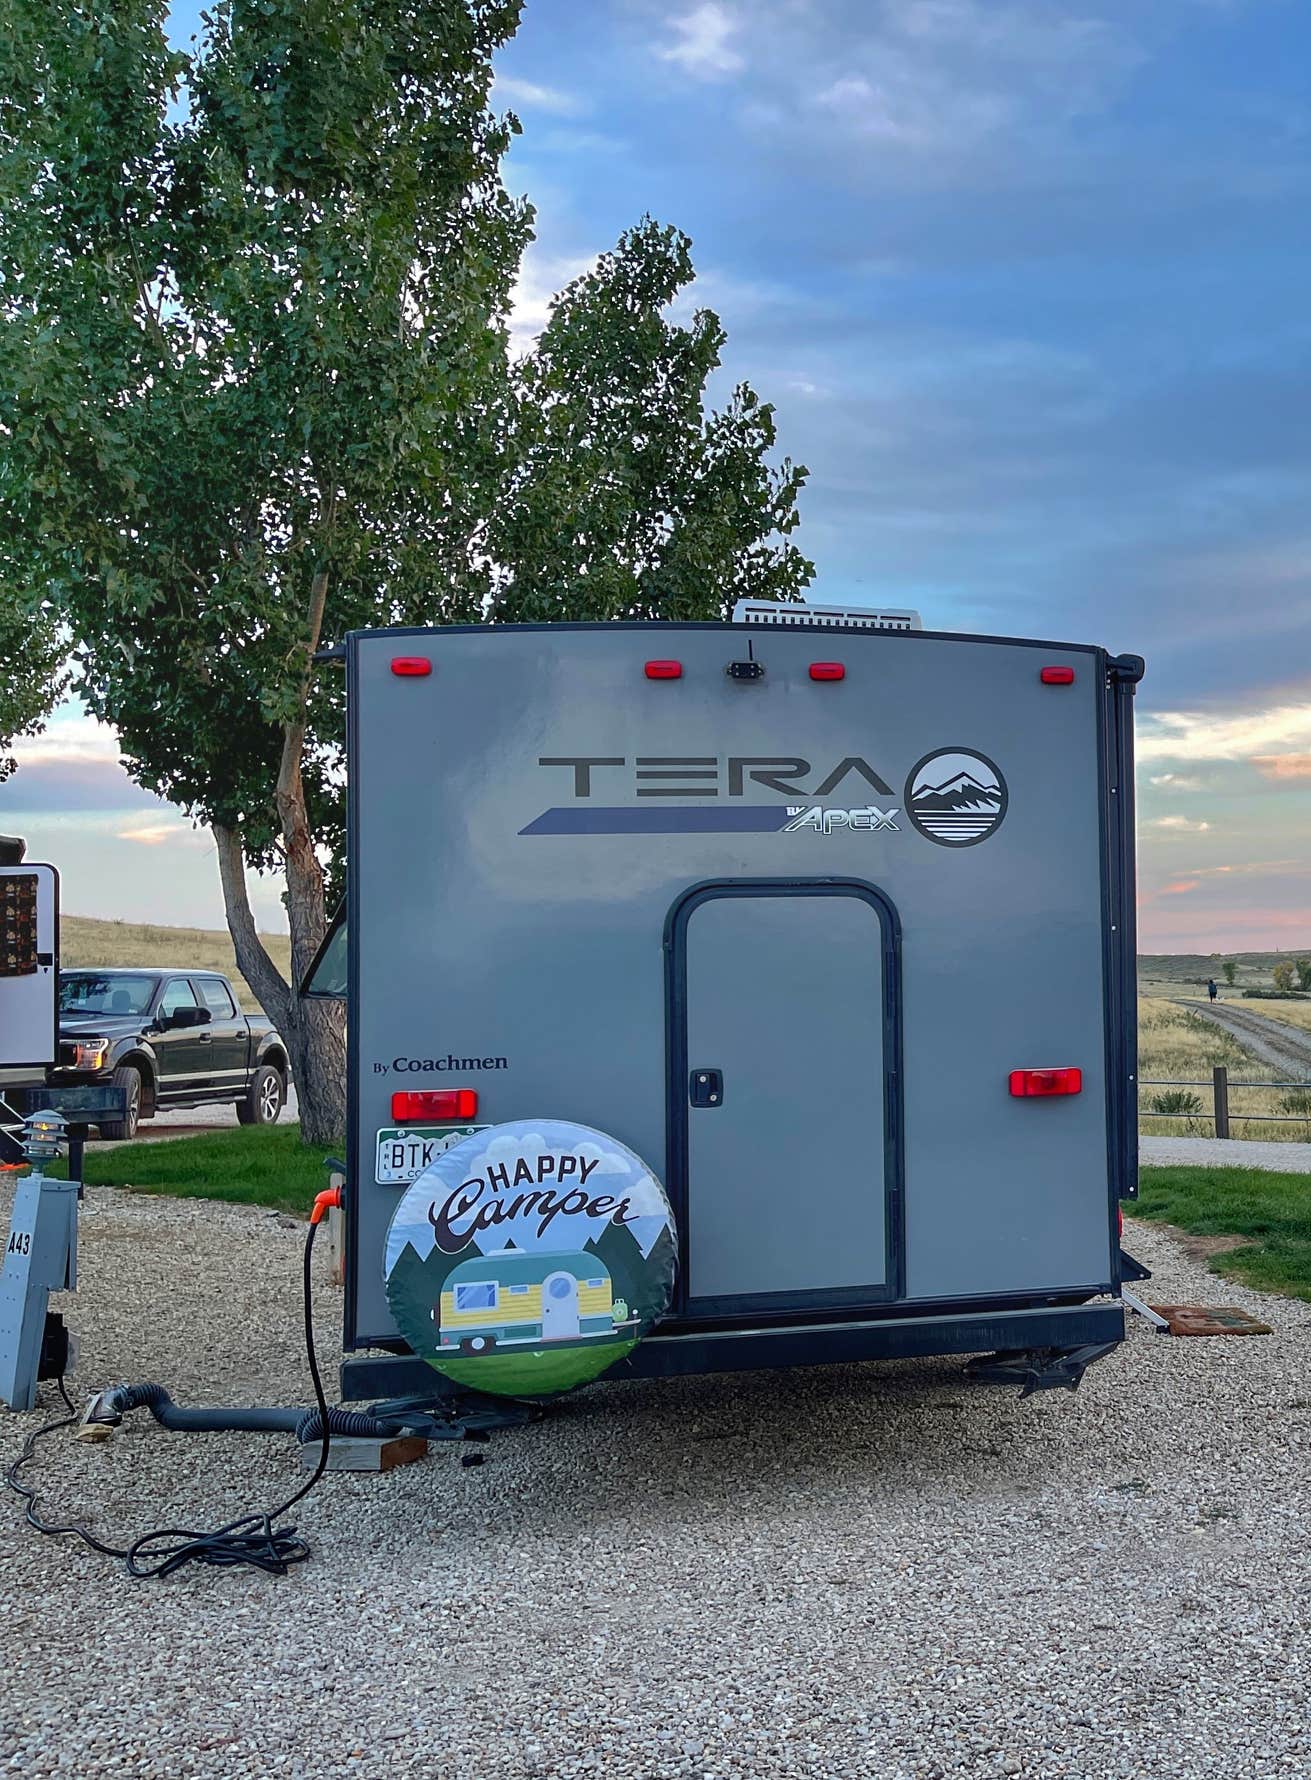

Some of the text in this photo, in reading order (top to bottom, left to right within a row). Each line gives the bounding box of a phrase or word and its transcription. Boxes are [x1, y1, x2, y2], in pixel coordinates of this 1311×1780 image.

[538, 757, 896, 798] TERA
[783, 805, 902, 835] APEX
[373, 1055, 508, 1076] By Coachmen
[486, 1155, 600, 1193] HAPPY
[427, 1177, 641, 1255] Camper
[7, 1231, 31, 1256] A43
